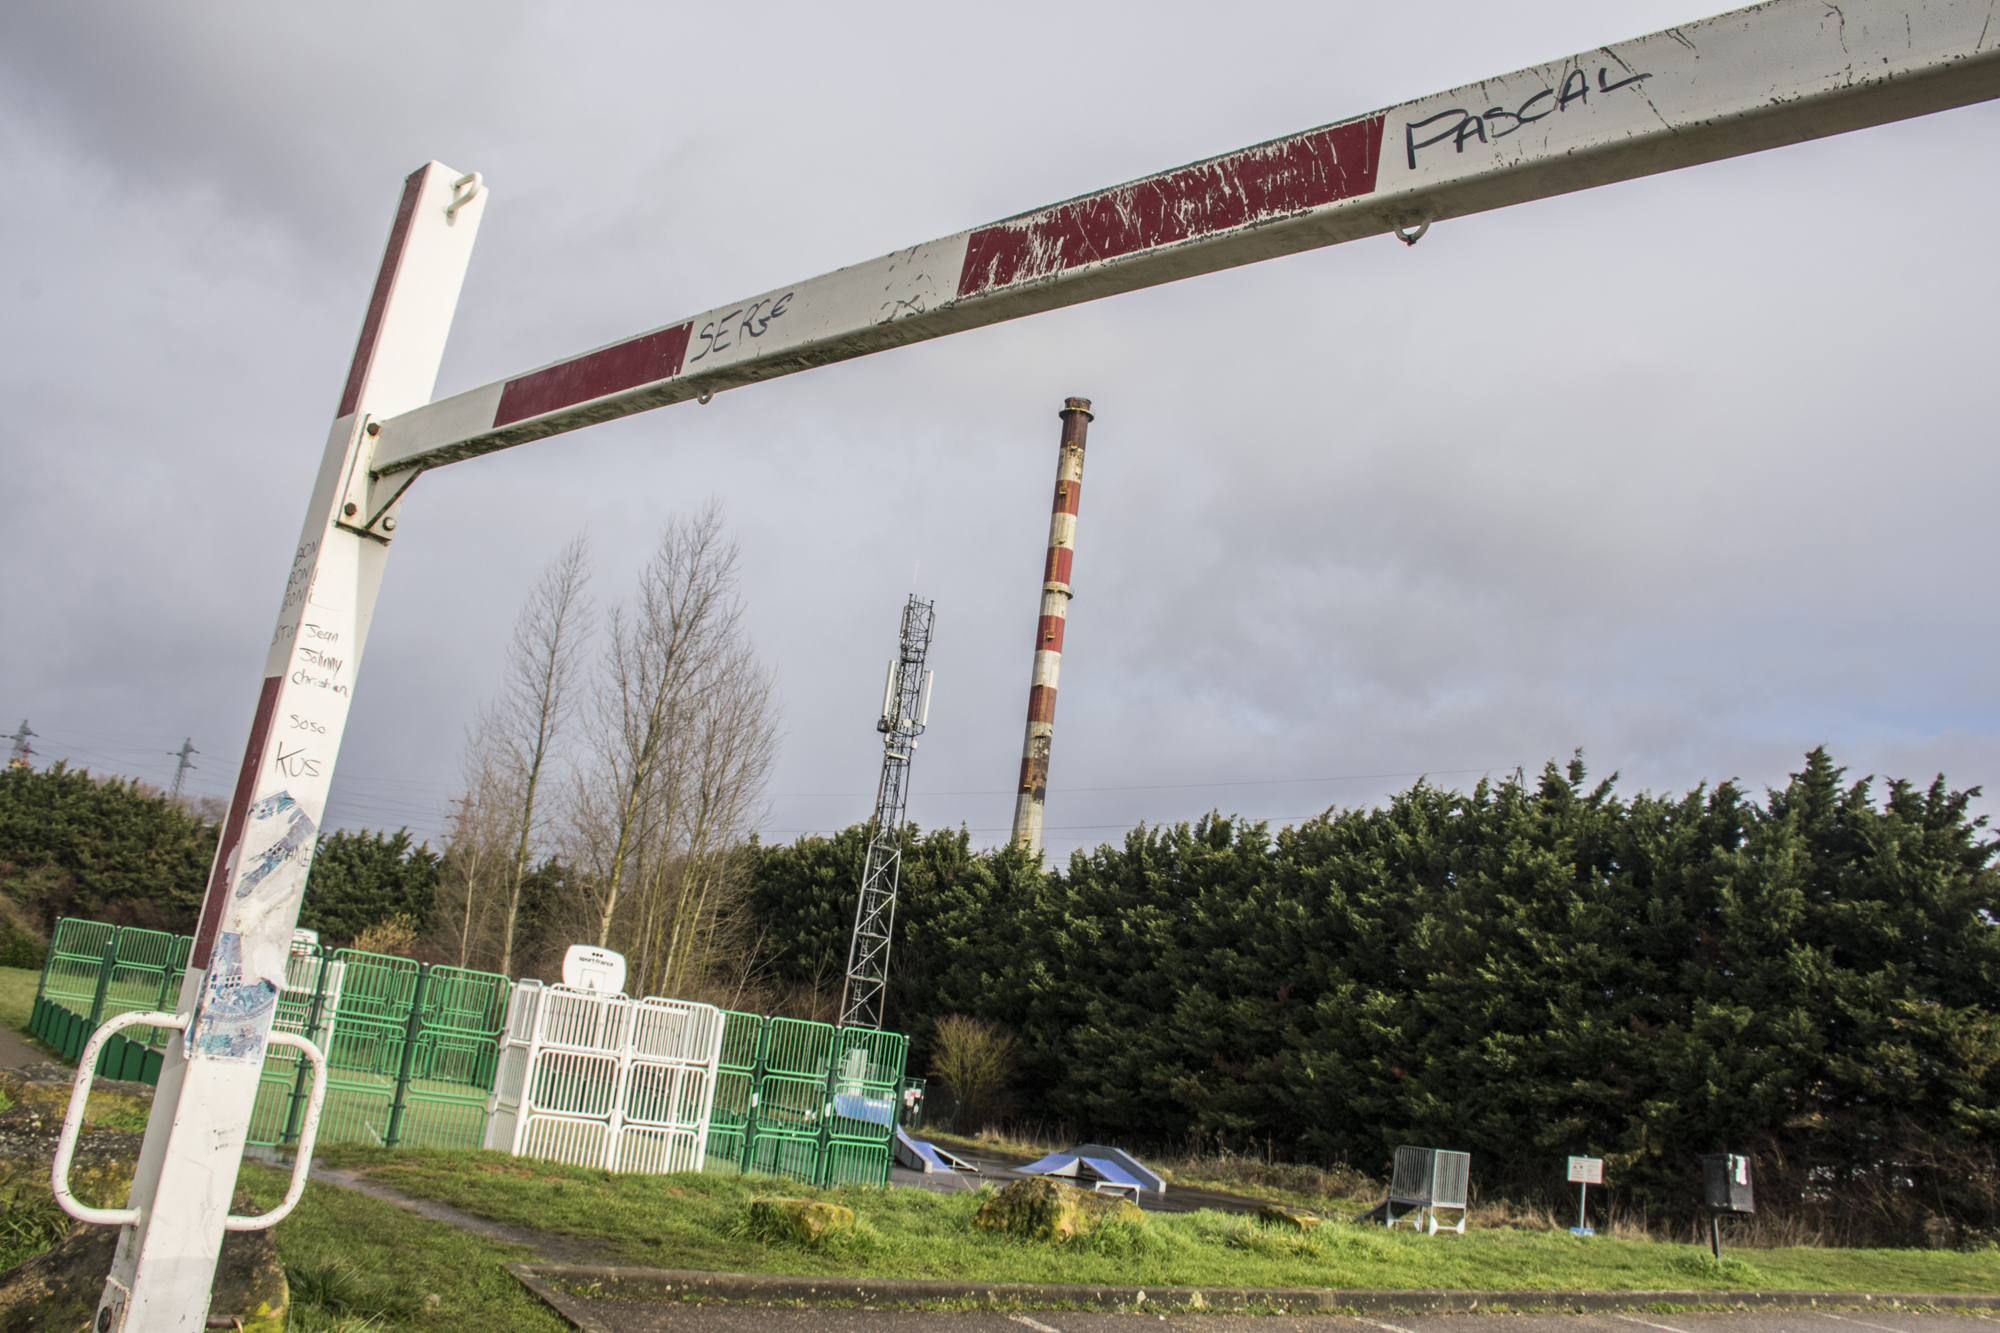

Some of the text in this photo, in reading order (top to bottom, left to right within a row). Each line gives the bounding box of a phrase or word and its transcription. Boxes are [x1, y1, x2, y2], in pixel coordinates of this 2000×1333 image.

[1404, 67, 1653, 170] PASCAL
[689, 291, 794, 364] SERGE
[305, 623, 339, 645] Jean
[275, 740, 322, 779] KUS
